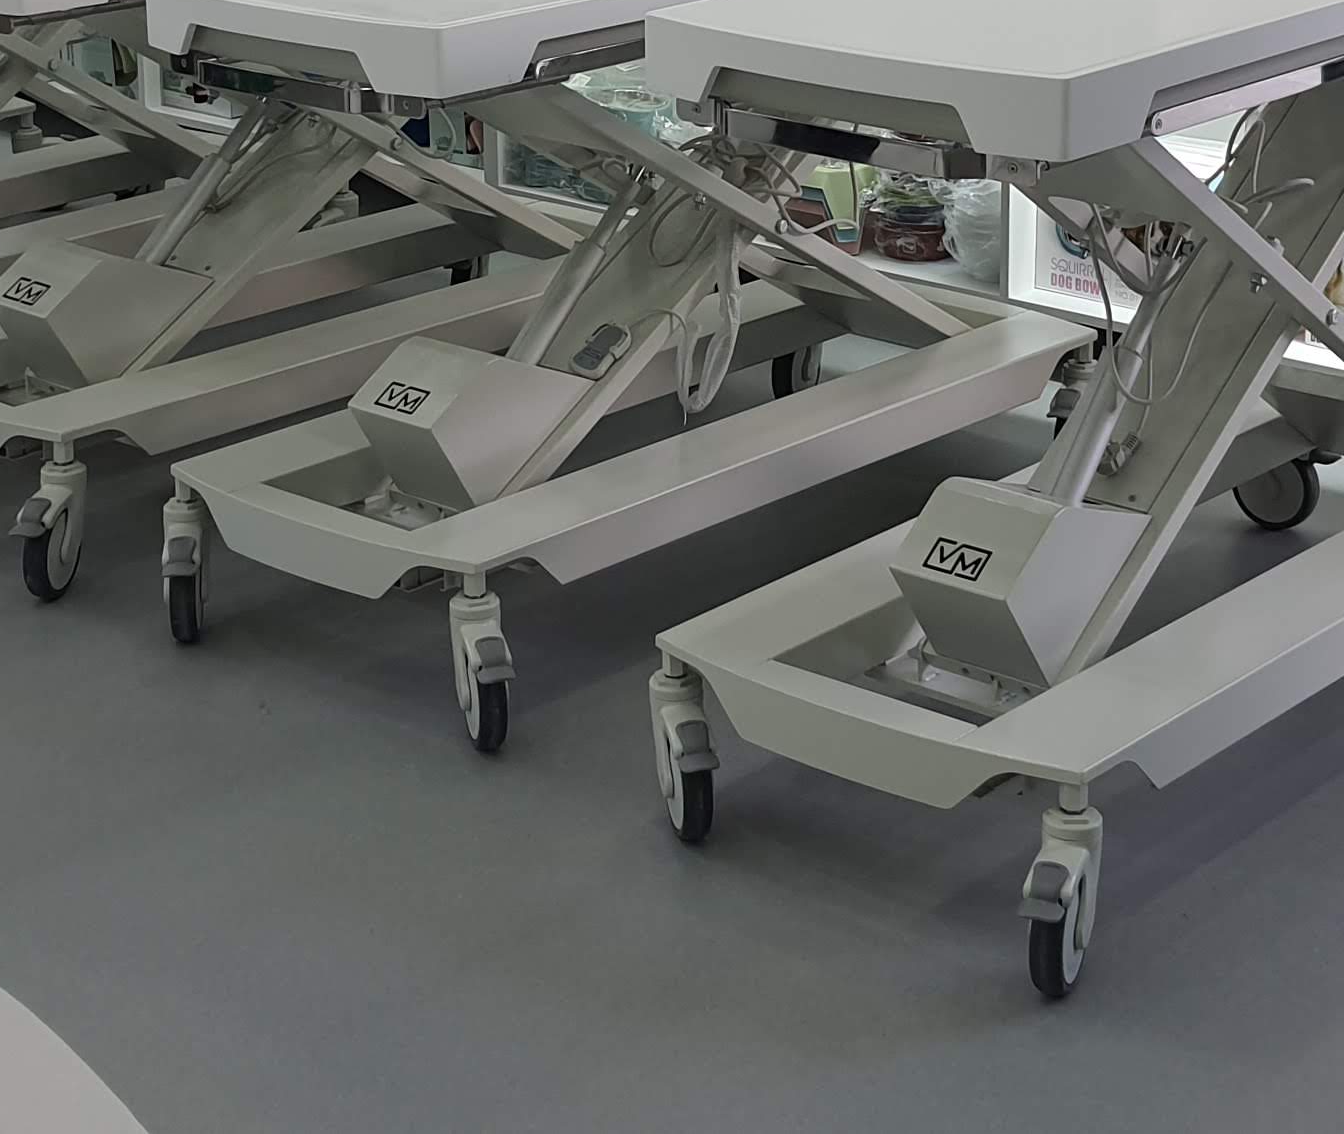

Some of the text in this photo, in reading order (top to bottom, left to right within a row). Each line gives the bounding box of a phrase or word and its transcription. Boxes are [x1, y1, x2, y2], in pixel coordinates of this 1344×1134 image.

[9, 280, 46, 303] VM
[1050, 272, 1073, 291] DOG
[383, 385, 426, 411] VM
[932, 541, 988, 577] VM
